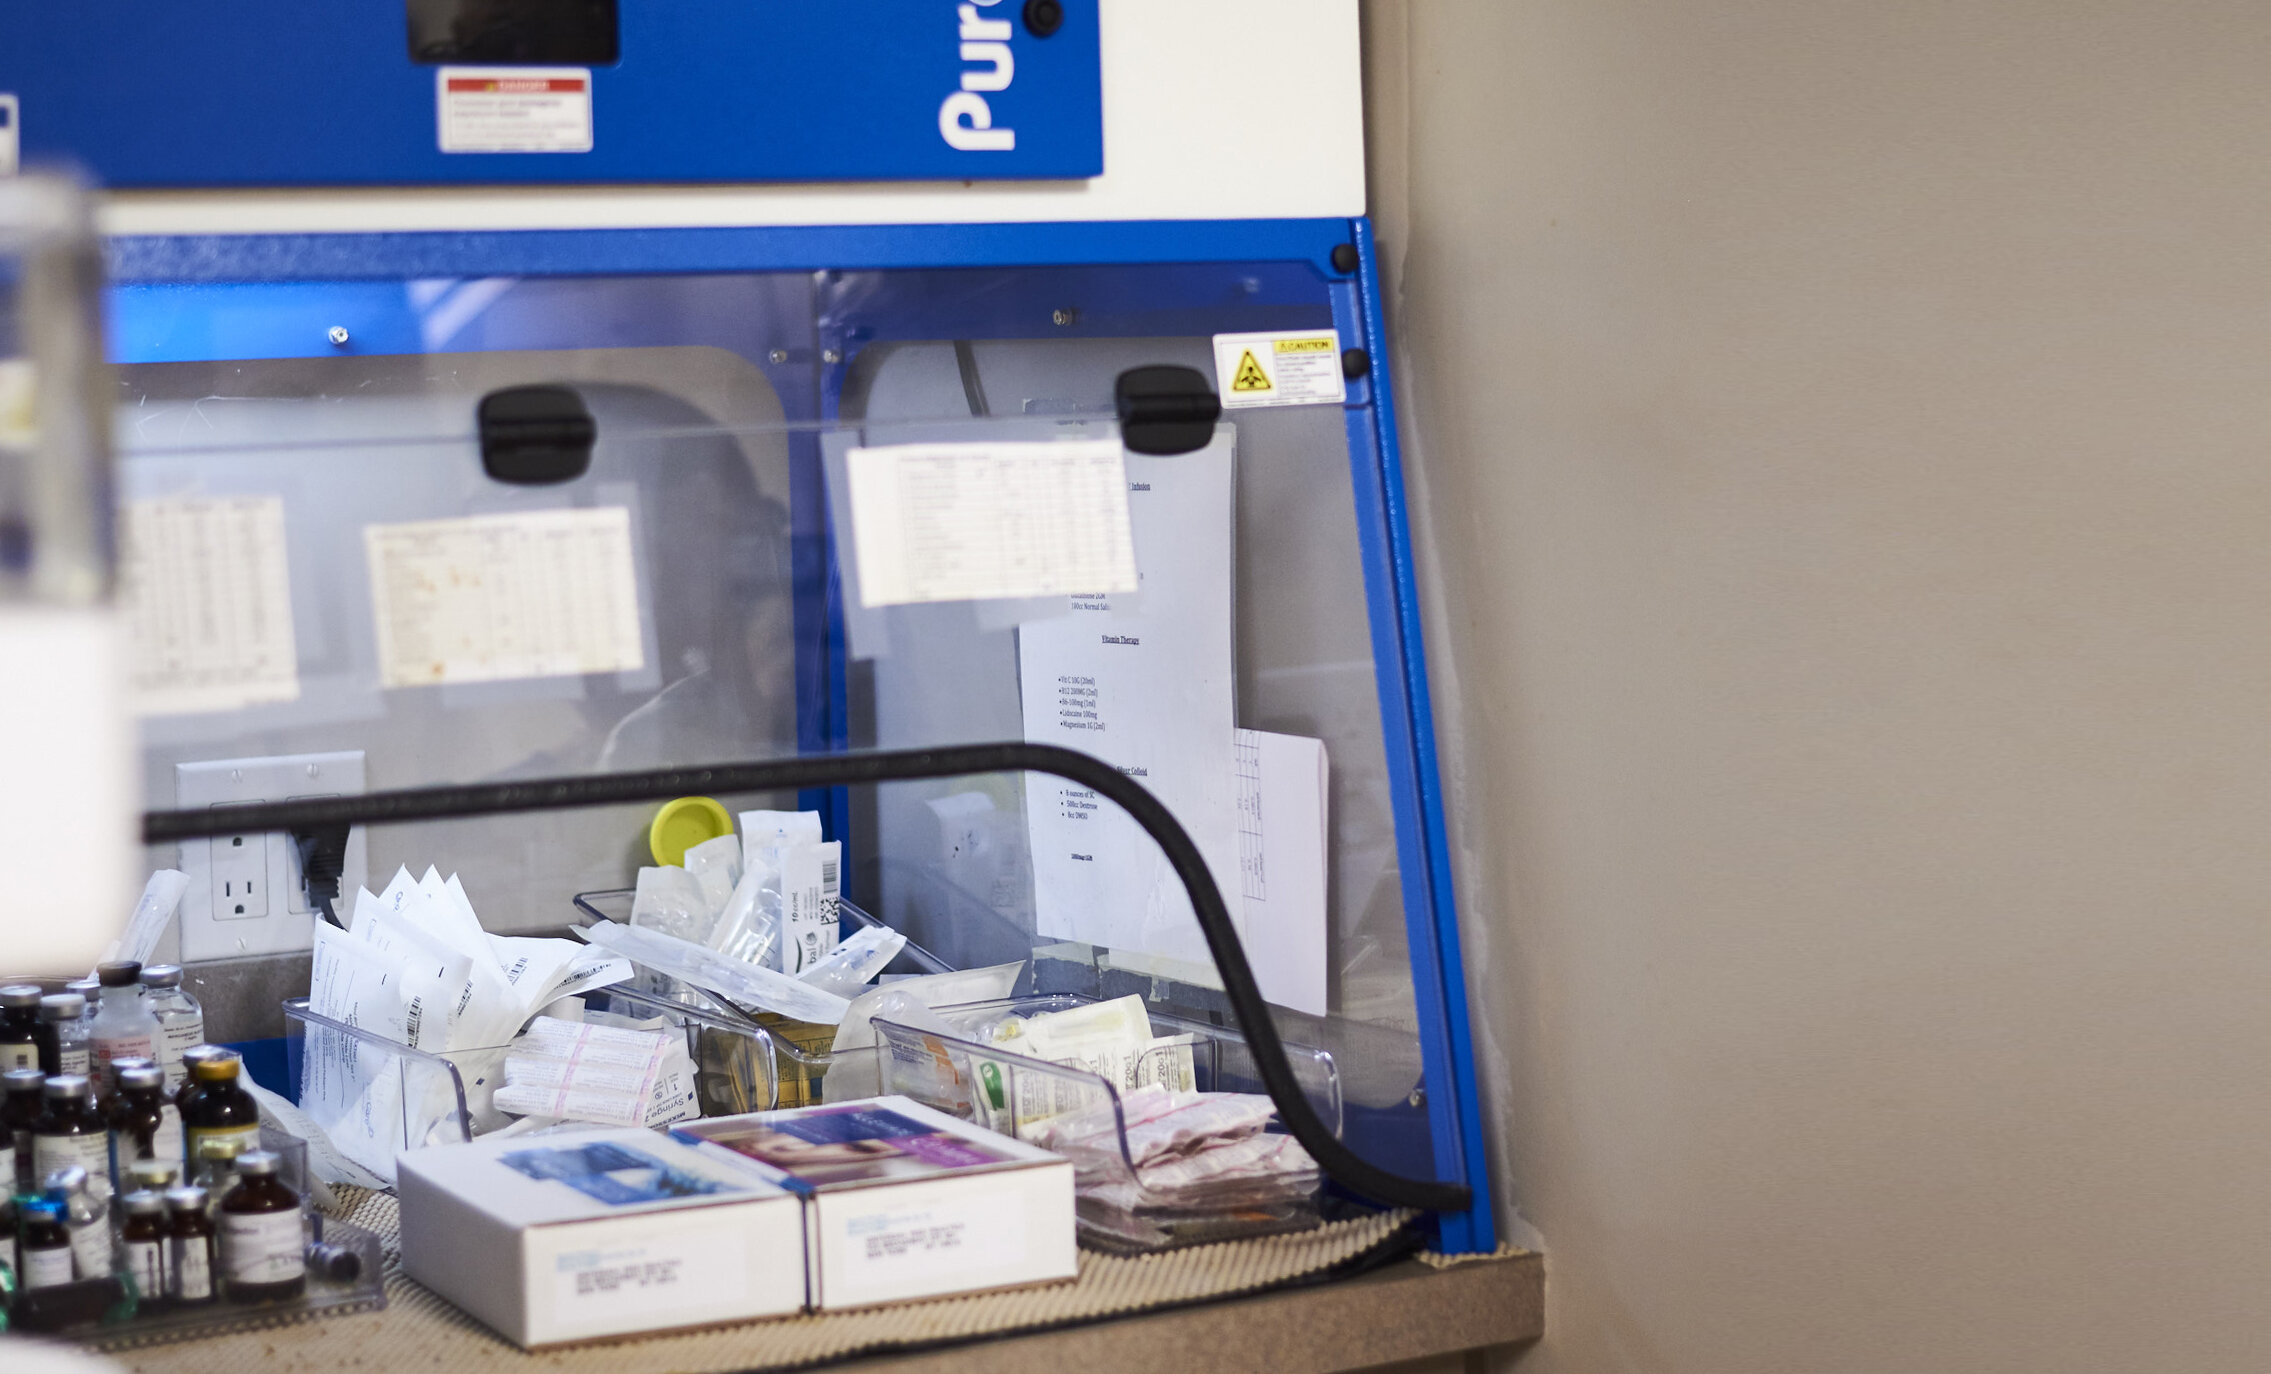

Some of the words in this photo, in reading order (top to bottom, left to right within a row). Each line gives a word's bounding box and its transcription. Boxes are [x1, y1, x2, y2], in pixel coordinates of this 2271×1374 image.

[938, 0, 1015, 151] Pur
[1288, 341, 1328, 350] CAUTION
[1132, 483, 1150, 491] Infusion
[1084, 602, 1099, 610] Normal
[1102, 635, 1119, 644] Vitamin
[1120, 635, 1139, 646] Therapy
[1063, 709, 1082, 718] Lidocaine
[1063, 720, 1086, 730] Magnesium
[1131, 766, 1148, 777] Colloid
[1080, 801, 1098, 809] Dextrose
[1076, 811, 1088, 820] DMSO
[651, 1098, 684, 1118] Syringe
